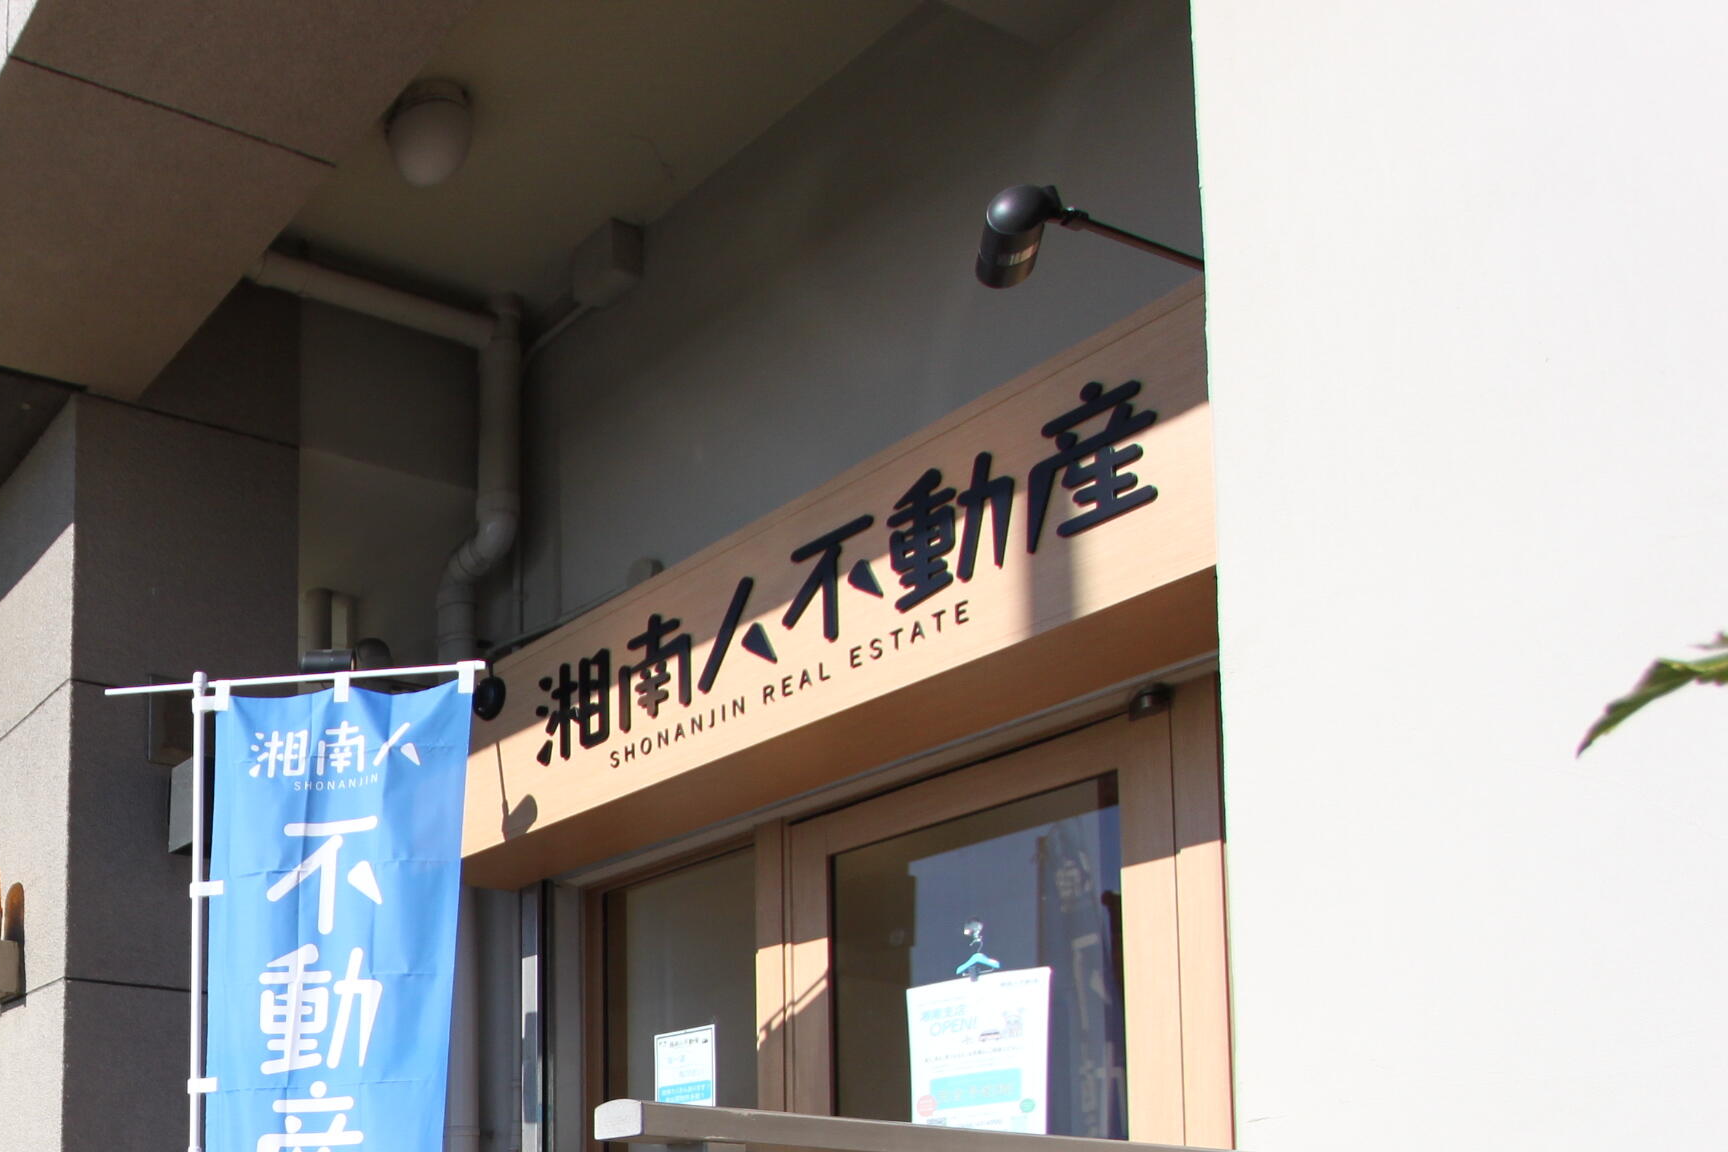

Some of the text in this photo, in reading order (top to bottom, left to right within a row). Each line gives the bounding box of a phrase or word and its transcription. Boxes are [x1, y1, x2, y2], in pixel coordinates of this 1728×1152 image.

[536, 379, 1158, 767] 湘南人不動産
[609, 600, 972, 770] SHONANJIN REAL ESTATE
[248, 719, 423, 779] 湘南人
[293, 772, 380, 792] SHONANJIN
